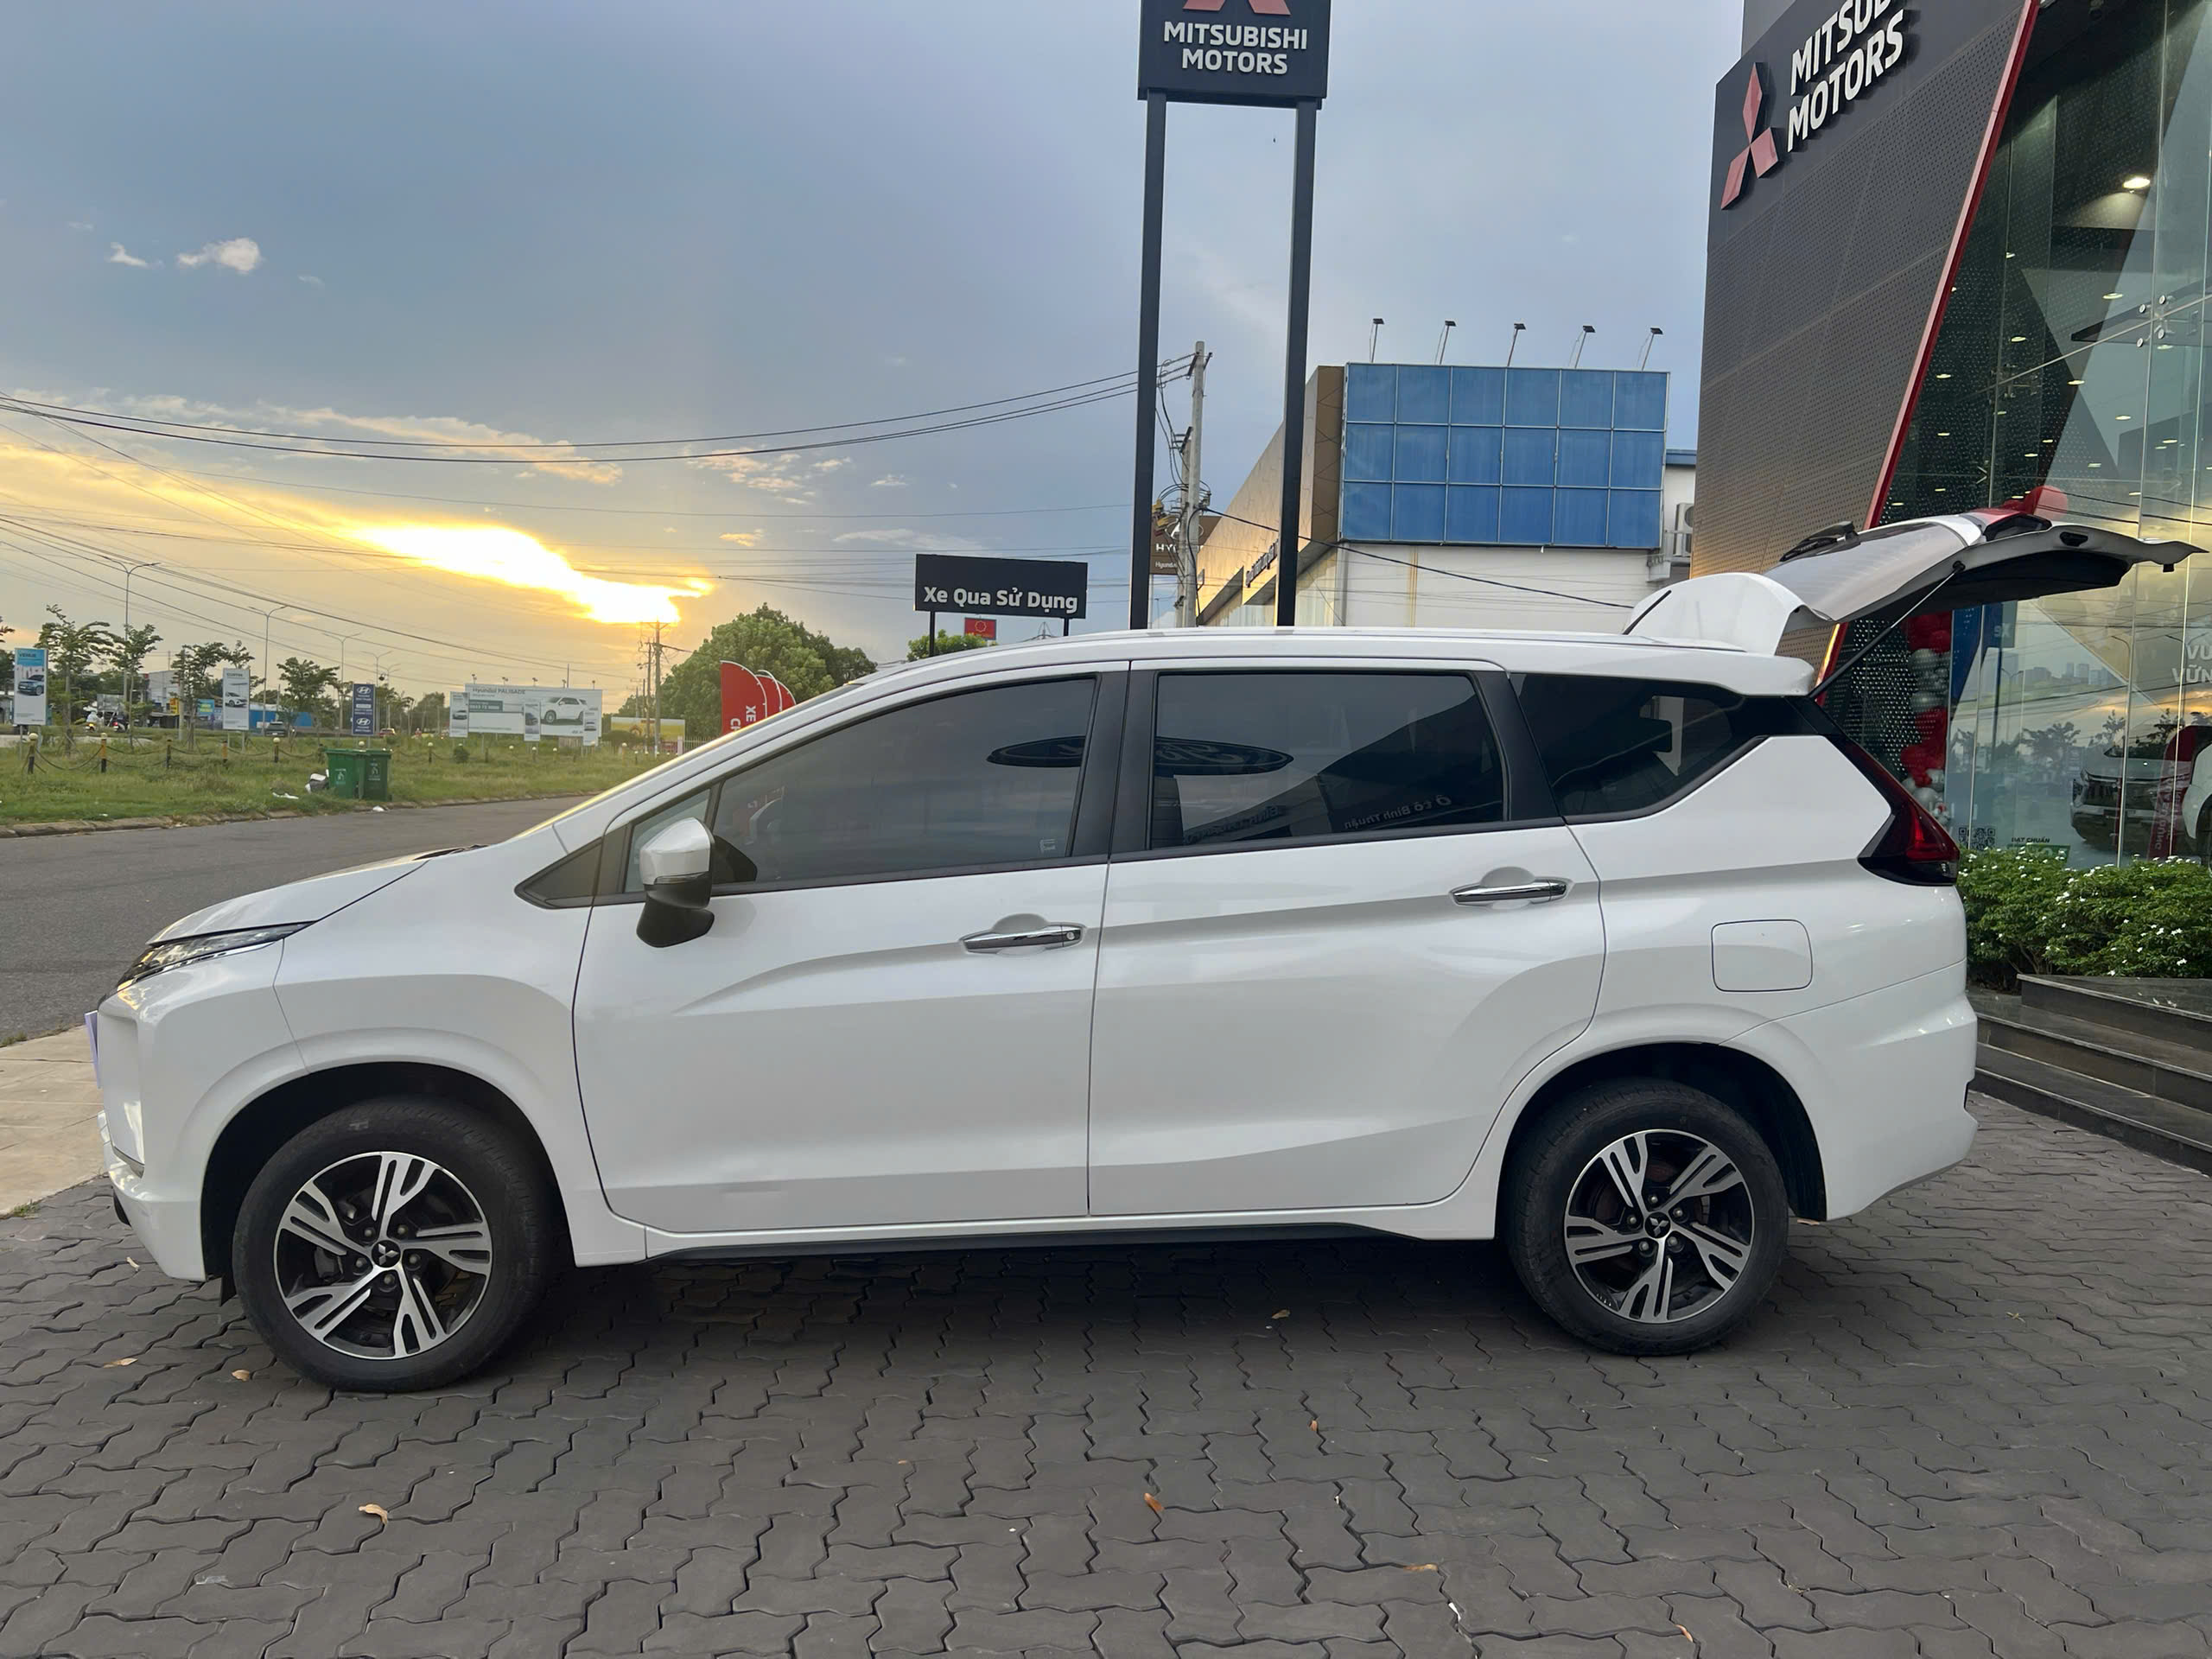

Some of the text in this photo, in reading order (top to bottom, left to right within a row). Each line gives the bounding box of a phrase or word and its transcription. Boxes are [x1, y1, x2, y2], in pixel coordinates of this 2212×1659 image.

[1163, 21, 1308, 49] MITSUBISHI
[1181, 48, 1288, 75] MOTORS
[1787, 9, 1904, 153] MOTORS
[923, 586, 1078, 613] Xe Qua Sử Dụng
[745, 705, 757, 722] XE
